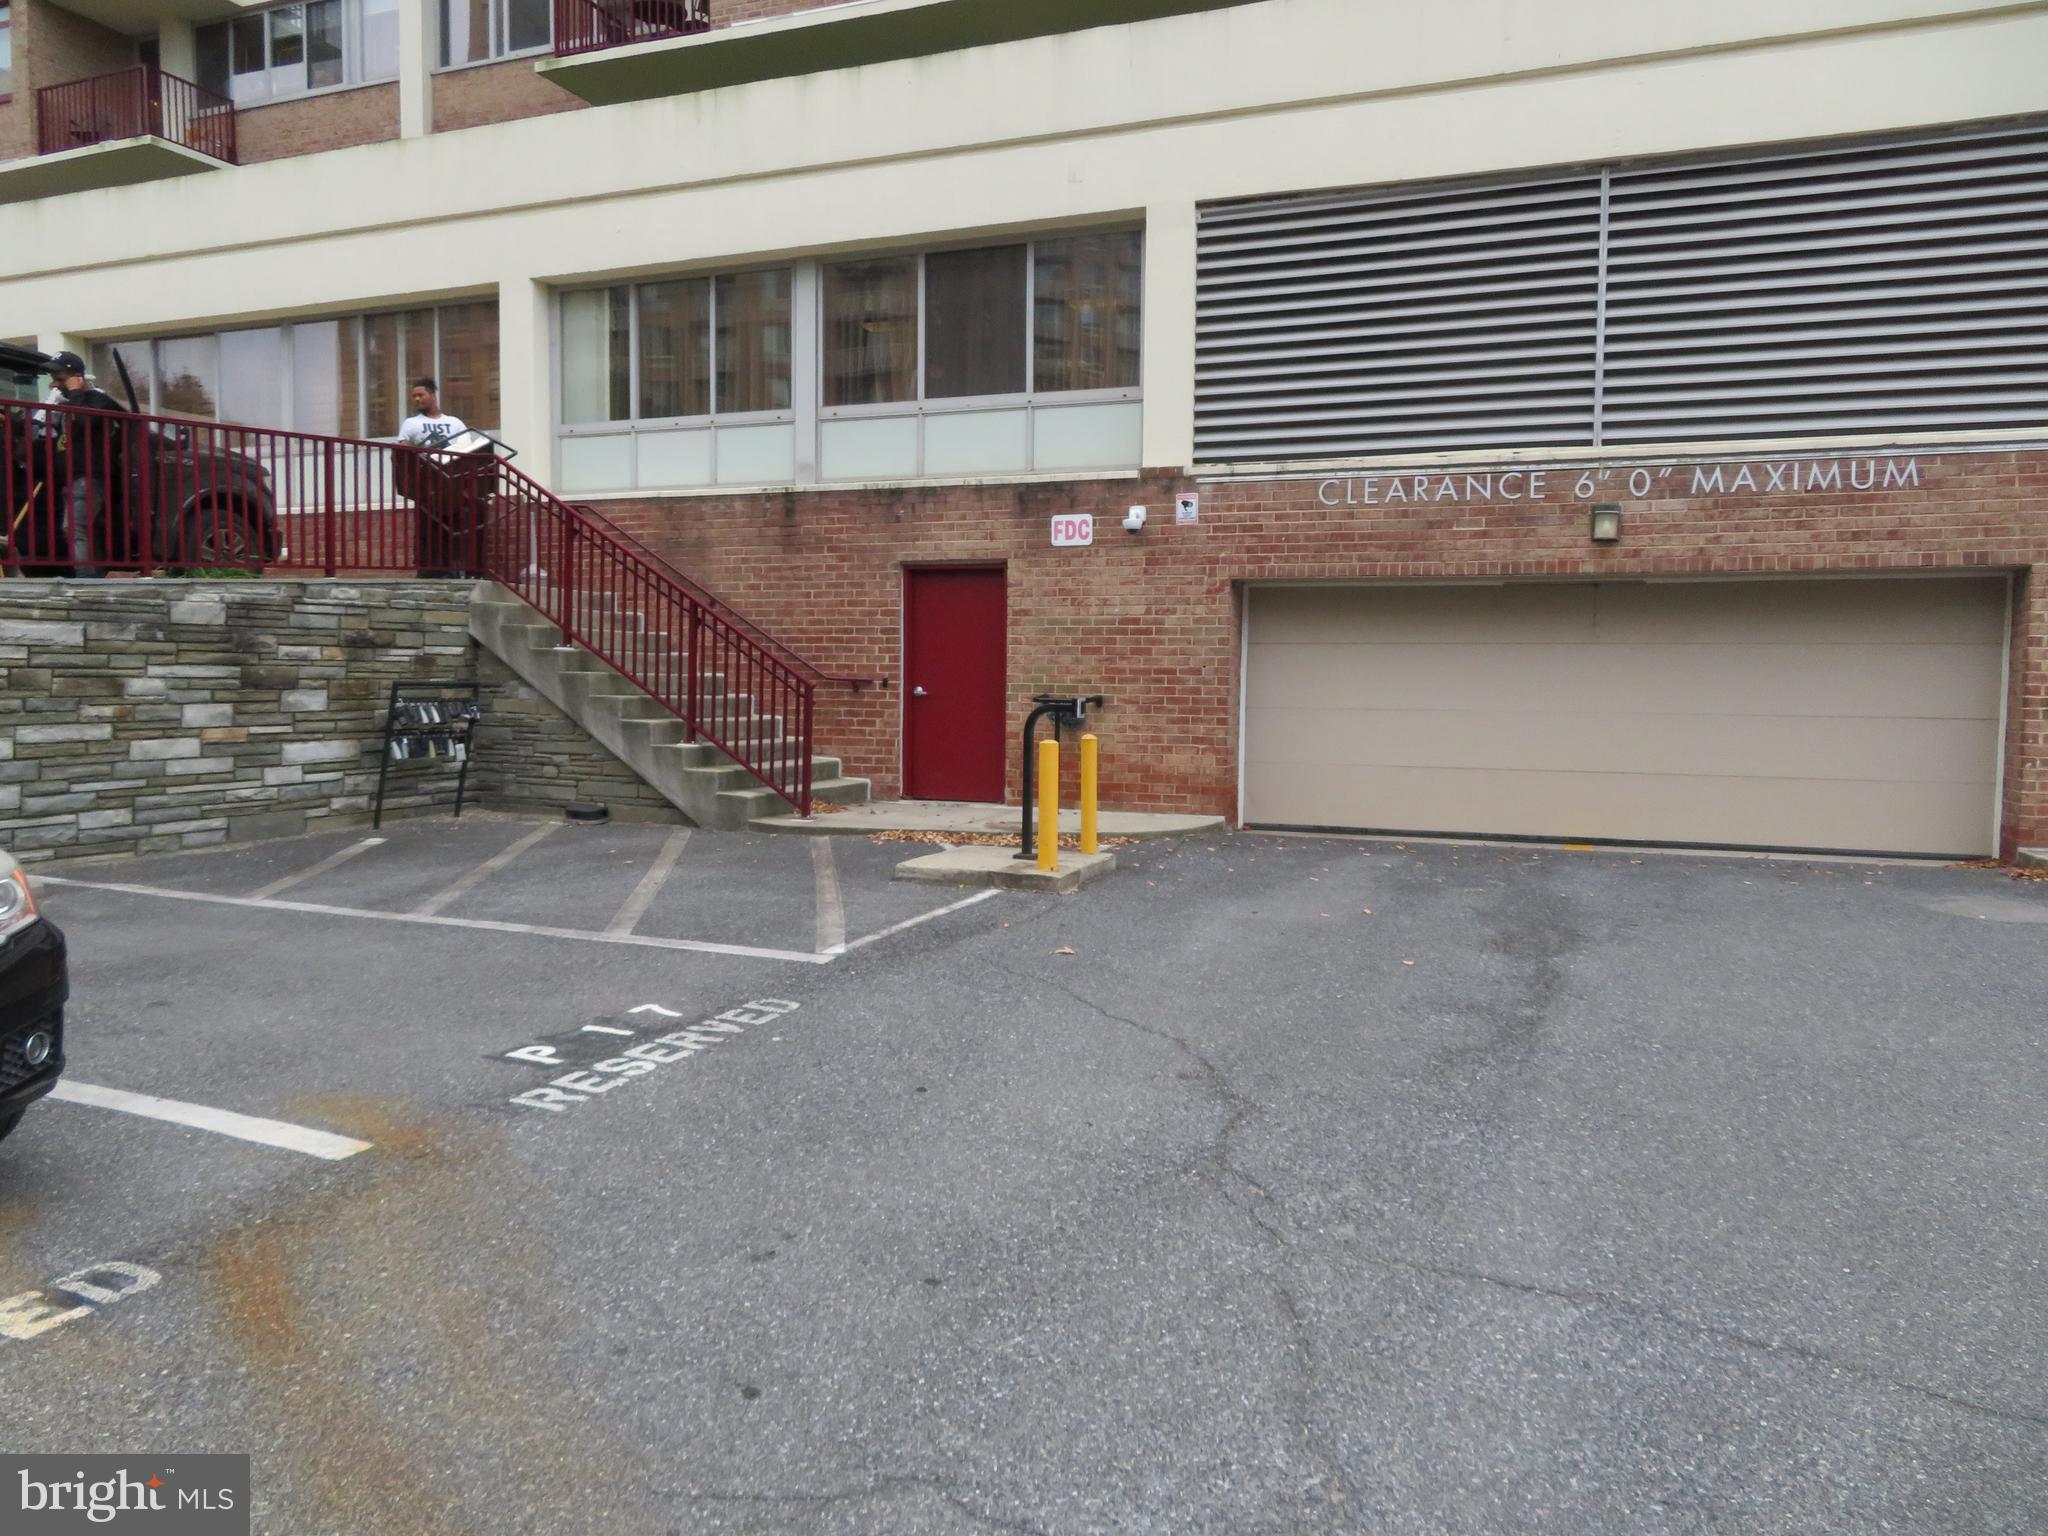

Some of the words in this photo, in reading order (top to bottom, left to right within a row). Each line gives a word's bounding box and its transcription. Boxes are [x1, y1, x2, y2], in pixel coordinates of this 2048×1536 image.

[422, 423, 451, 434] JUST
[1318, 471, 1546, 506] CLEARANCE
[1691, 458, 1920, 495] MAXIMUM
[1053, 519, 1090, 541] FDC
[509, 998, 801, 1112] RESERVED
